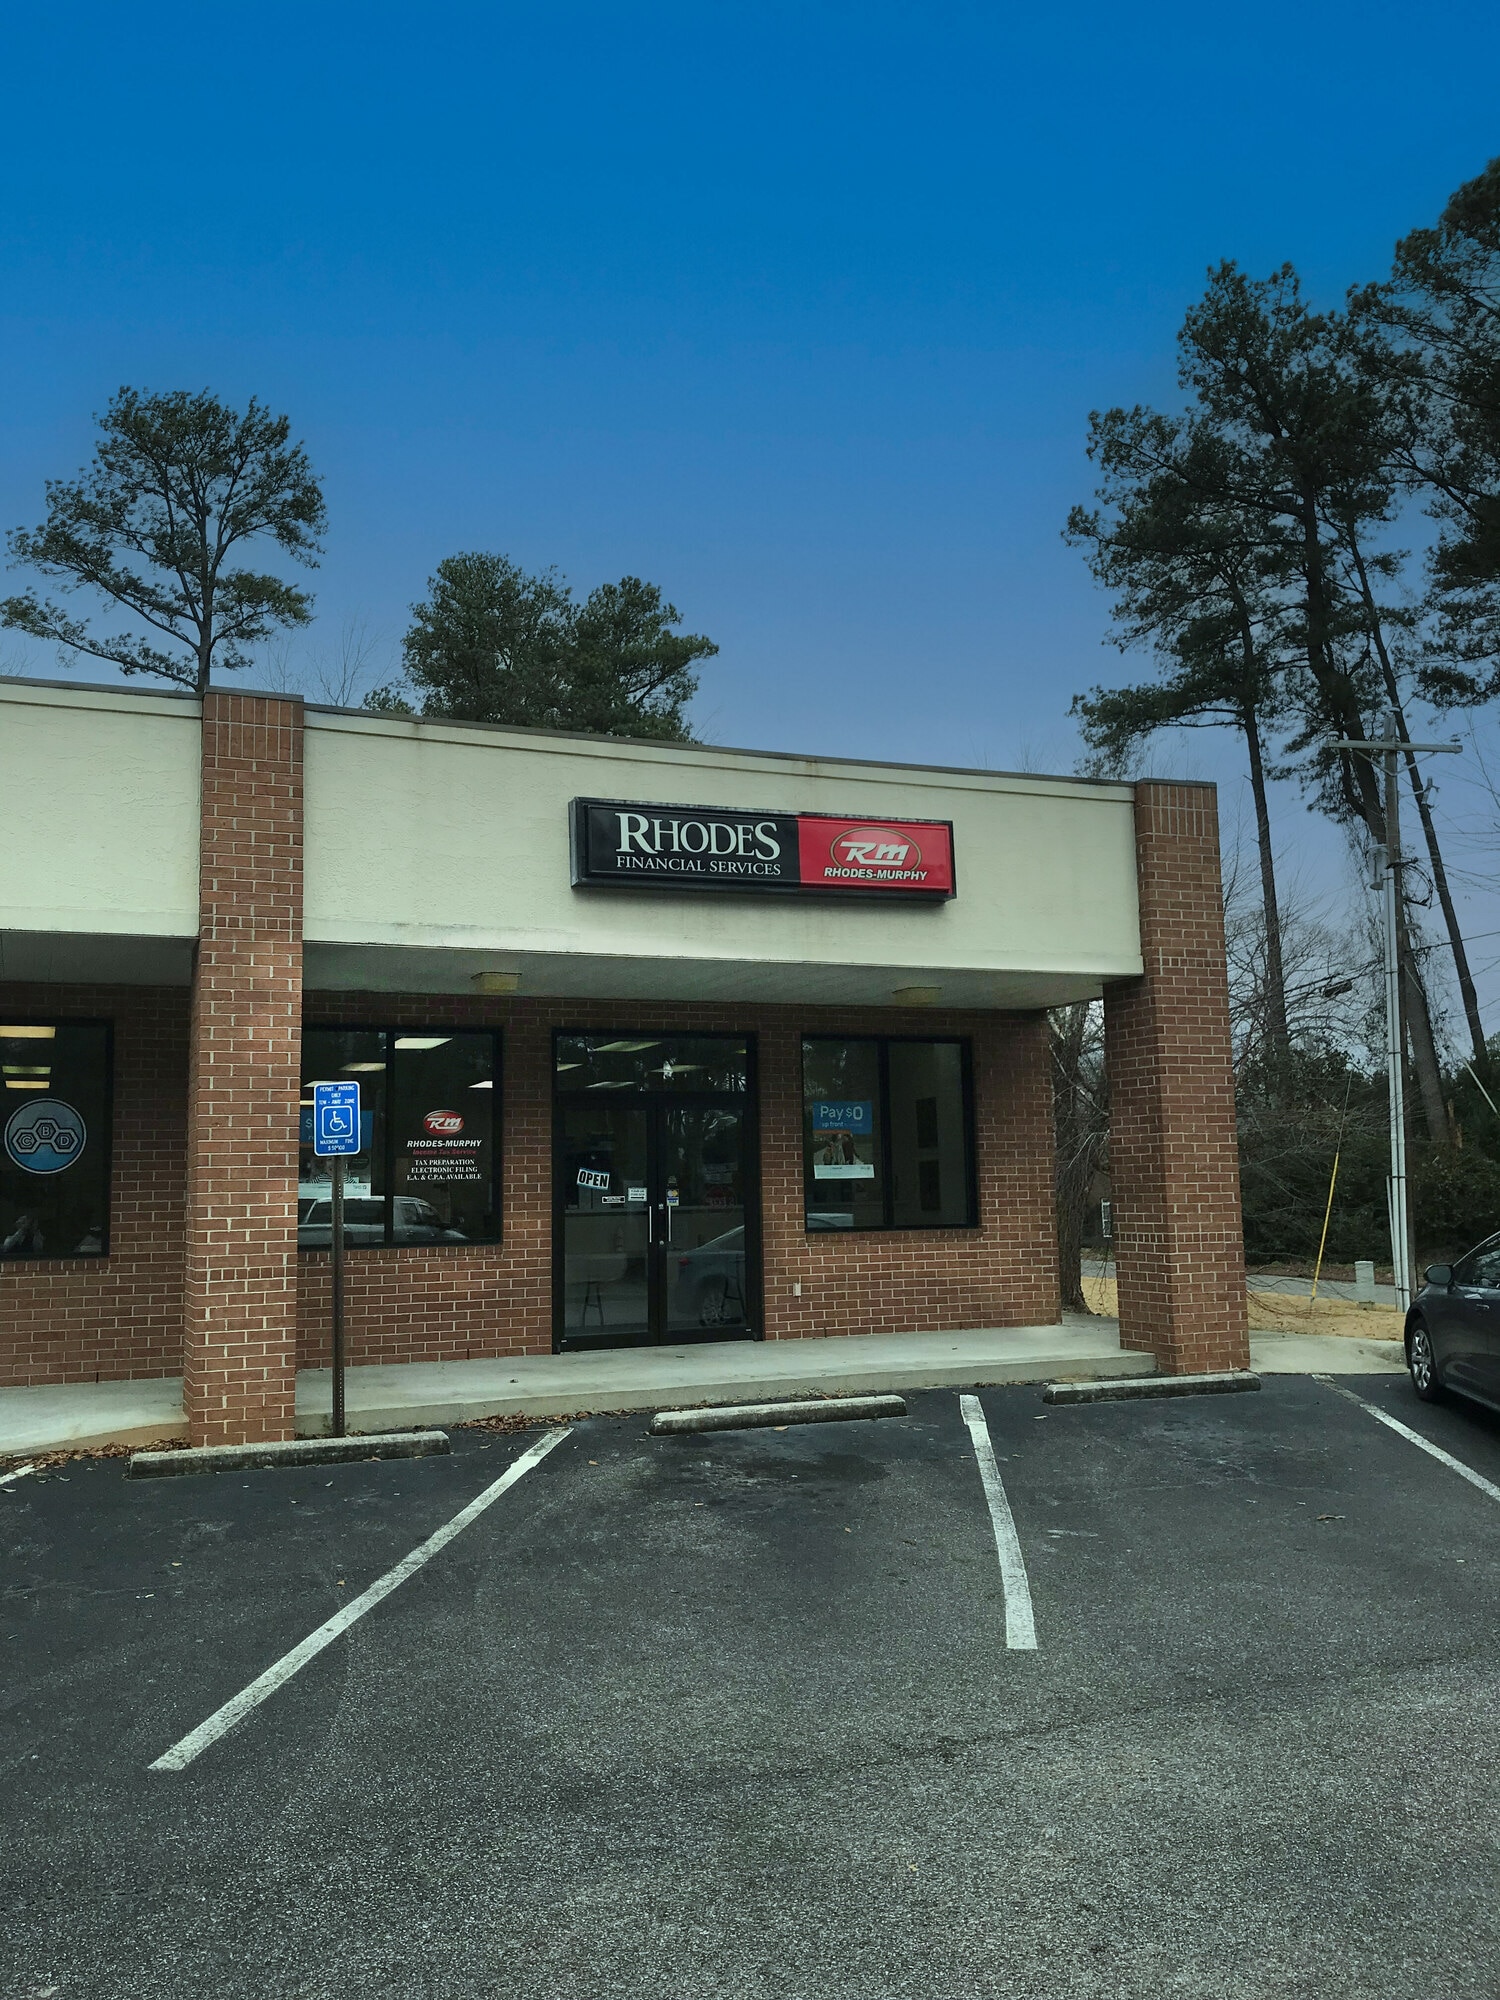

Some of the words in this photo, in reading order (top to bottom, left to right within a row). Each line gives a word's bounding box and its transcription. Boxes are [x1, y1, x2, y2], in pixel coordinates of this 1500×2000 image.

[615, 813, 781, 860] RHODES
[616, 856, 705, 871] FINANCIAL
[709, 861, 781, 875] SERVICES
[824, 867, 927, 880] RHODES-MURPHY
[820, 1105, 844, 1121] Pay
[846, 1106, 864, 1120] $0
[406, 1140, 482, 1148] RHODES-MURPHY
[579, 1171, 608, 1187] OPEN
